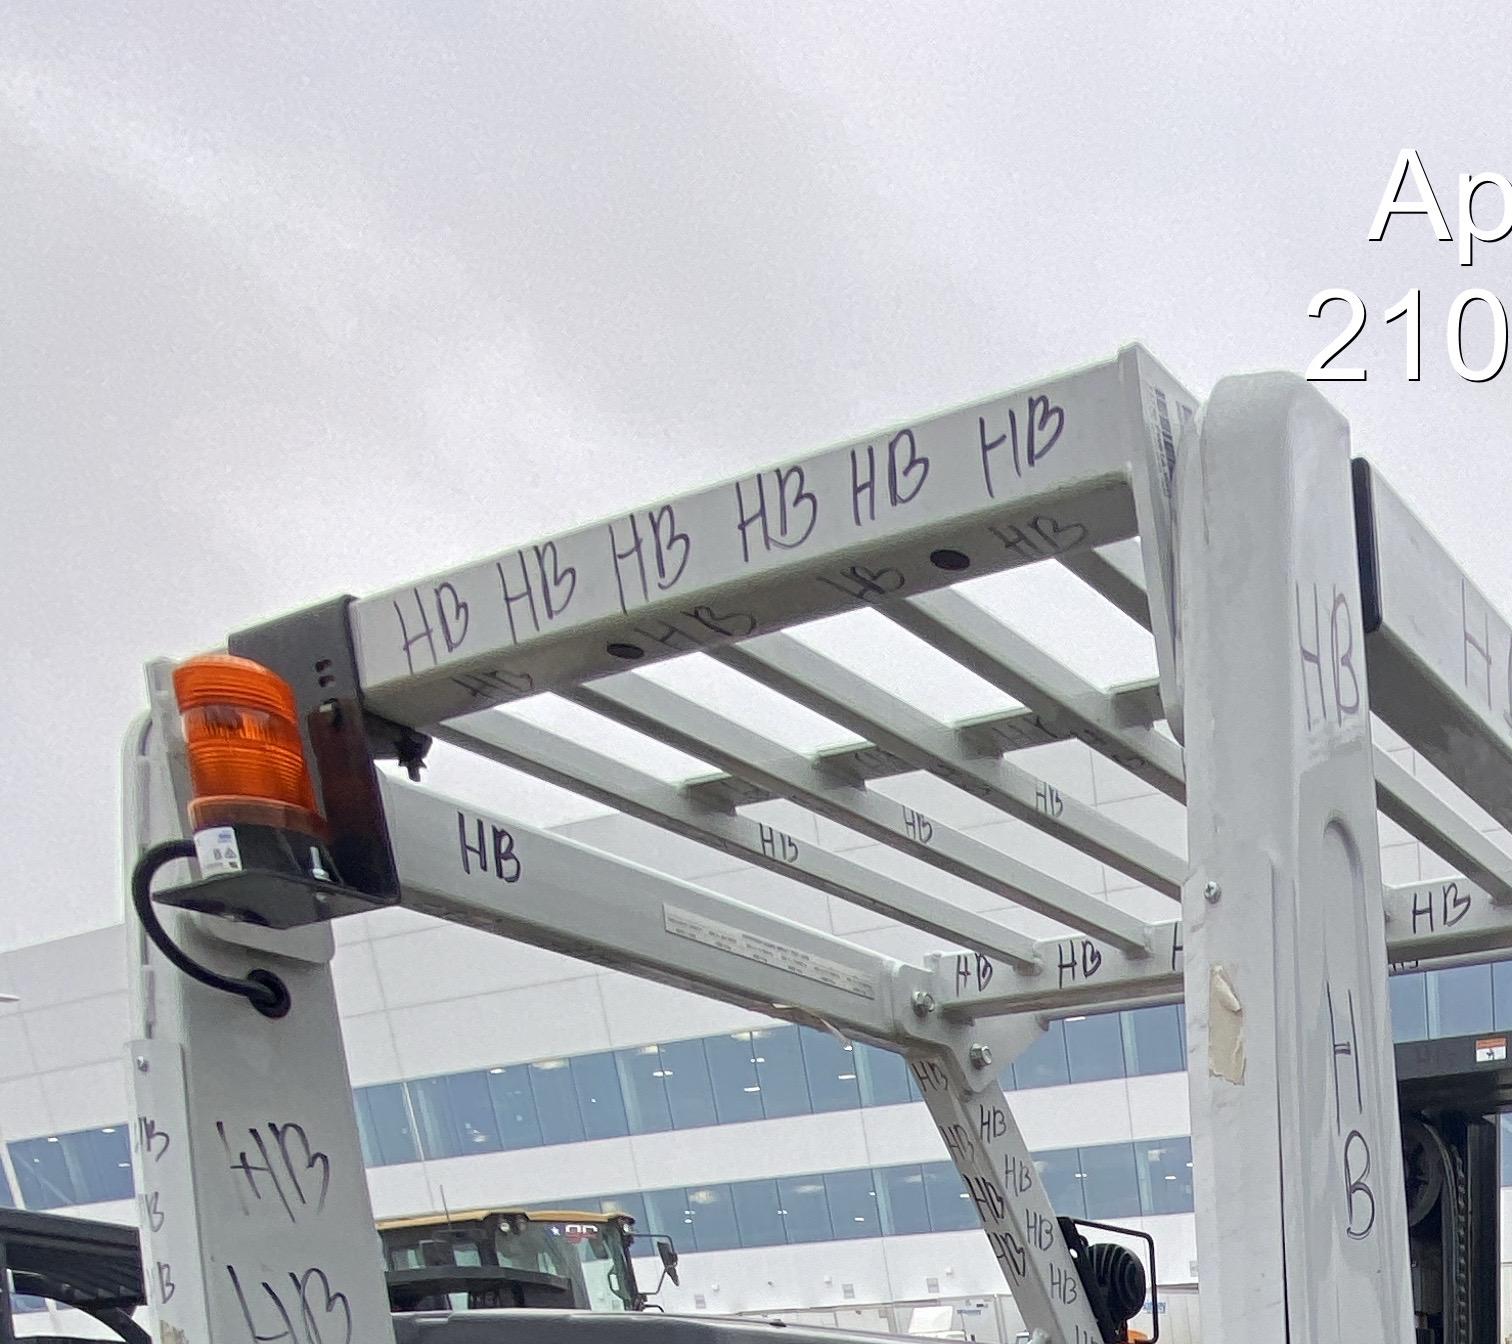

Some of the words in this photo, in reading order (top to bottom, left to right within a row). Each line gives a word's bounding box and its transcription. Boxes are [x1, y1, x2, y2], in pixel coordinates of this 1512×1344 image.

[402, 581, 469, 674] HB
[499, 541, 576, 644] HB
[609, 504, 689, 612] HB
[736, 464, 816, 561] HB
[851, 430, 929, 526] HB
[979, 395, 1064, 498] HB
[457, 811, 521, 883] HB
[1058, 940, 1101, 987] HB
[1412, 883, 1470, 933] HB
[216, 1121, 330, 1223] HB
